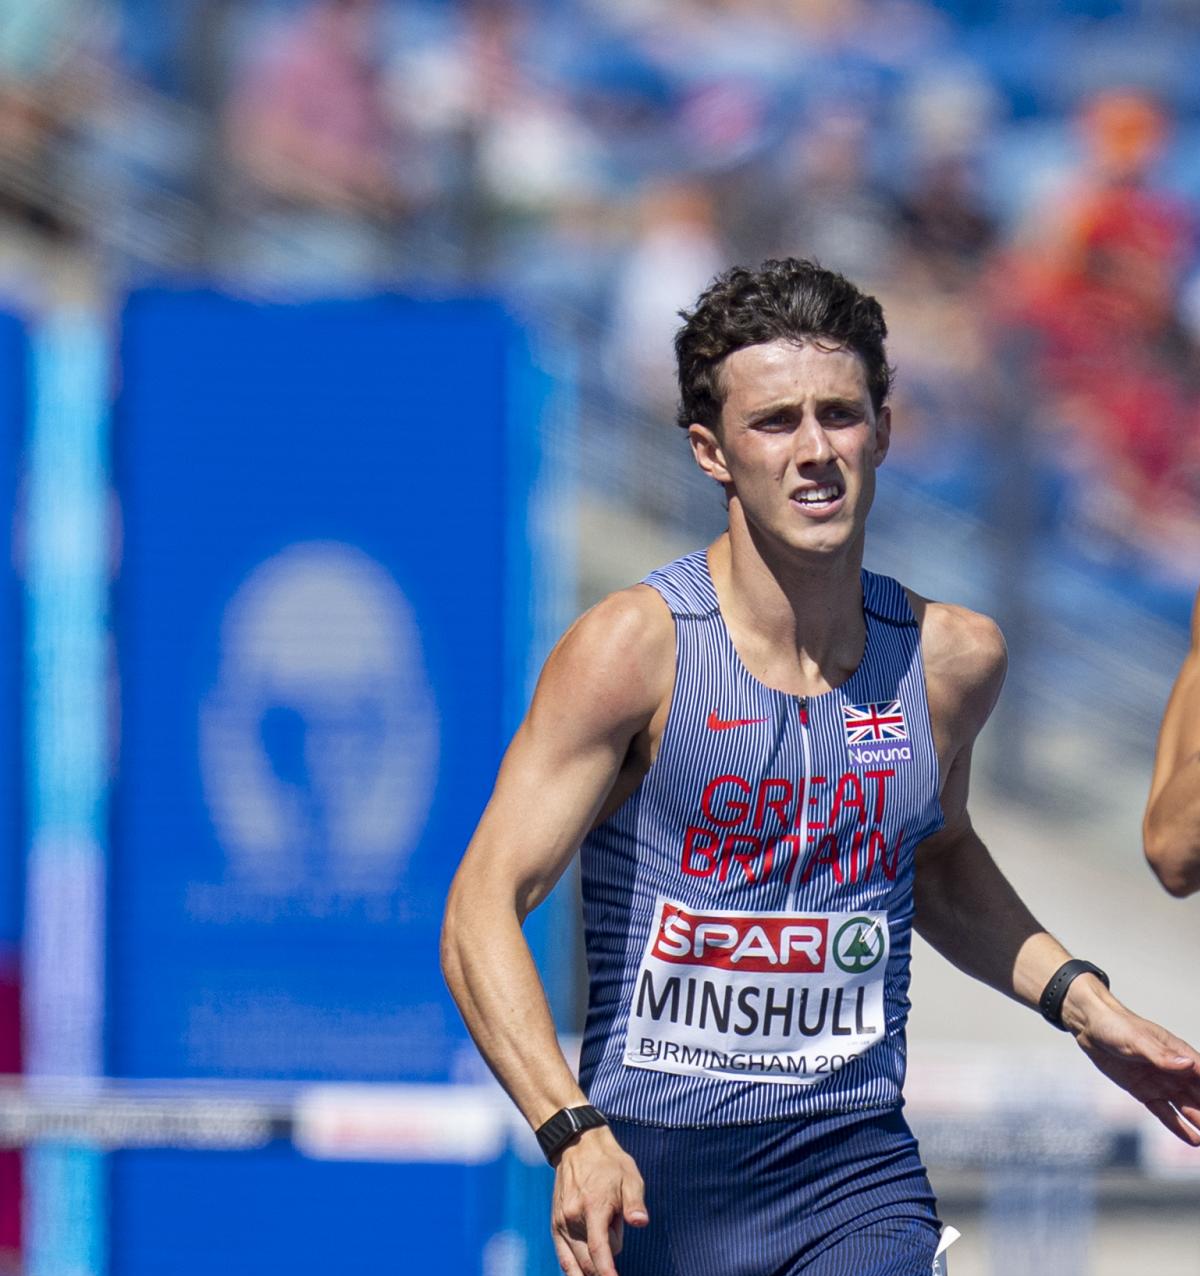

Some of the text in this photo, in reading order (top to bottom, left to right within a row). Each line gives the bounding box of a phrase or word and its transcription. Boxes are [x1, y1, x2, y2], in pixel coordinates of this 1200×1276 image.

[849, 746, 911, 766] Novuna
[701, 769, 895, 831] GREAT
[681, 823, 904, 885] BRITAIN
[657, 914, 822, 965] SPAR
[636, 969, 877, 1037] MINSHULL
[640, 1037, 808, 1074] BIRMINGHAM
